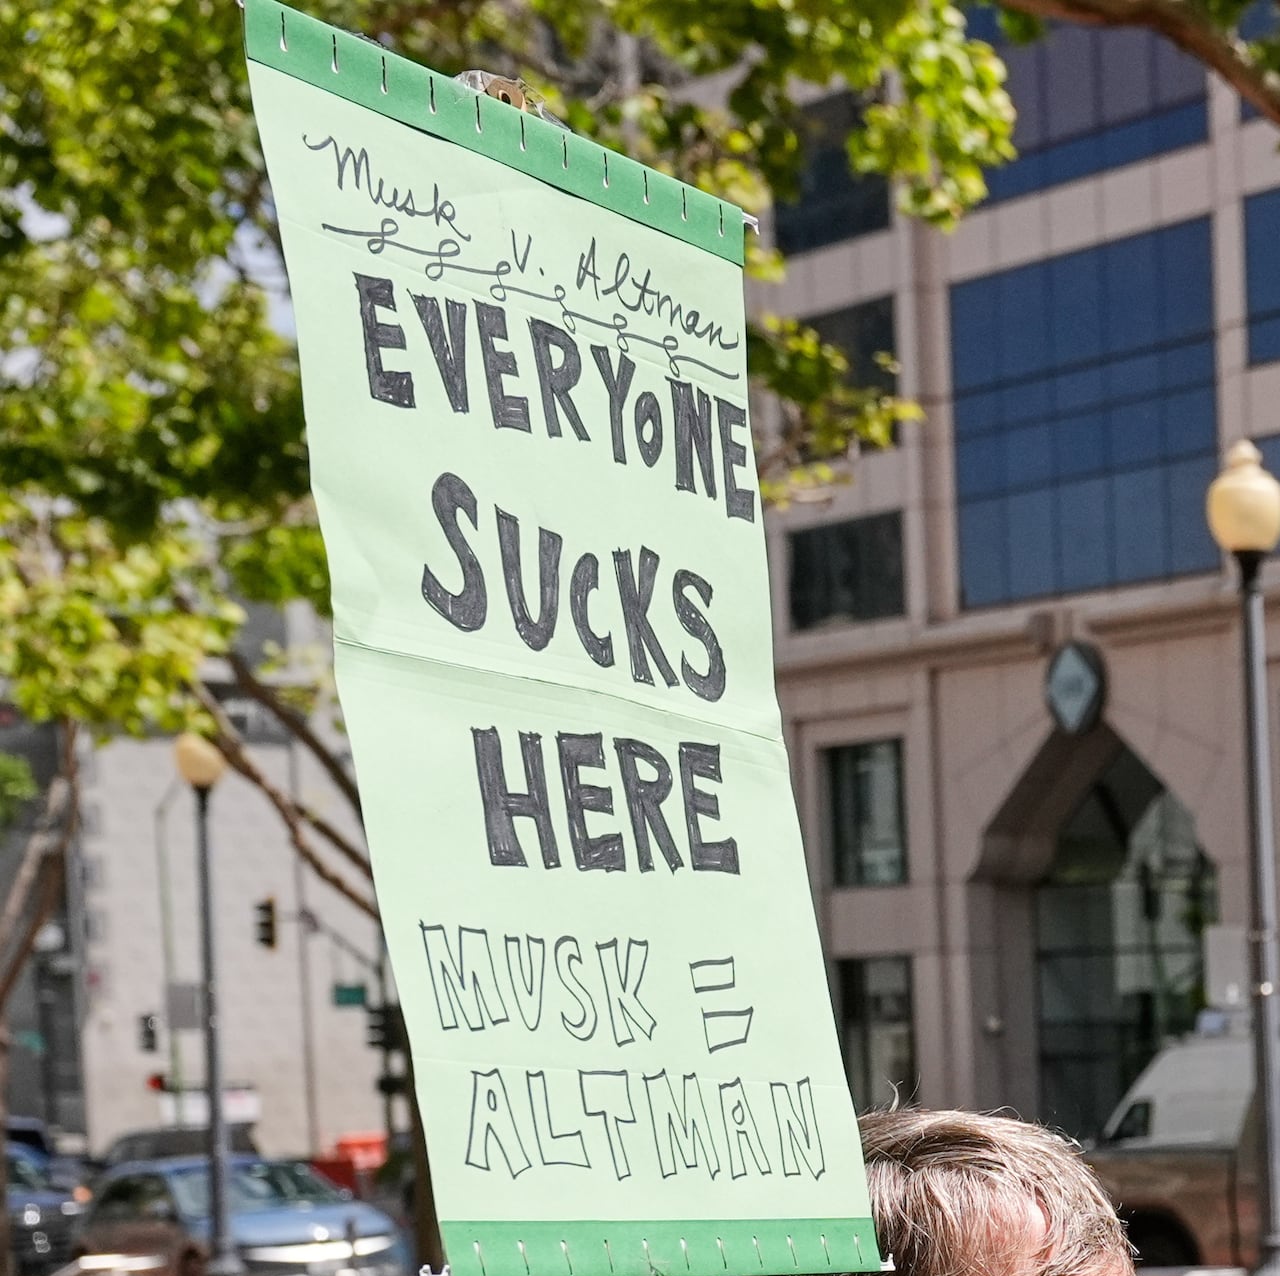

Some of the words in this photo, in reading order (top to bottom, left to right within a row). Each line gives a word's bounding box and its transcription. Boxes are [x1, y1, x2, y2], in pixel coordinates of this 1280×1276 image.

[302, 132, 471, 242] Musk
[575, 236, 739, 350] Altman
[352, 271, 756, 523] EVERYONE
[421, 471, 728, 701] SUCKS
[470, 725, 741, 875] HERE
[418, 919, 658, 1047] MUSK
[688, 955, 754, 1053] =
[465, 1068, 826, 1181] ALTMAN
